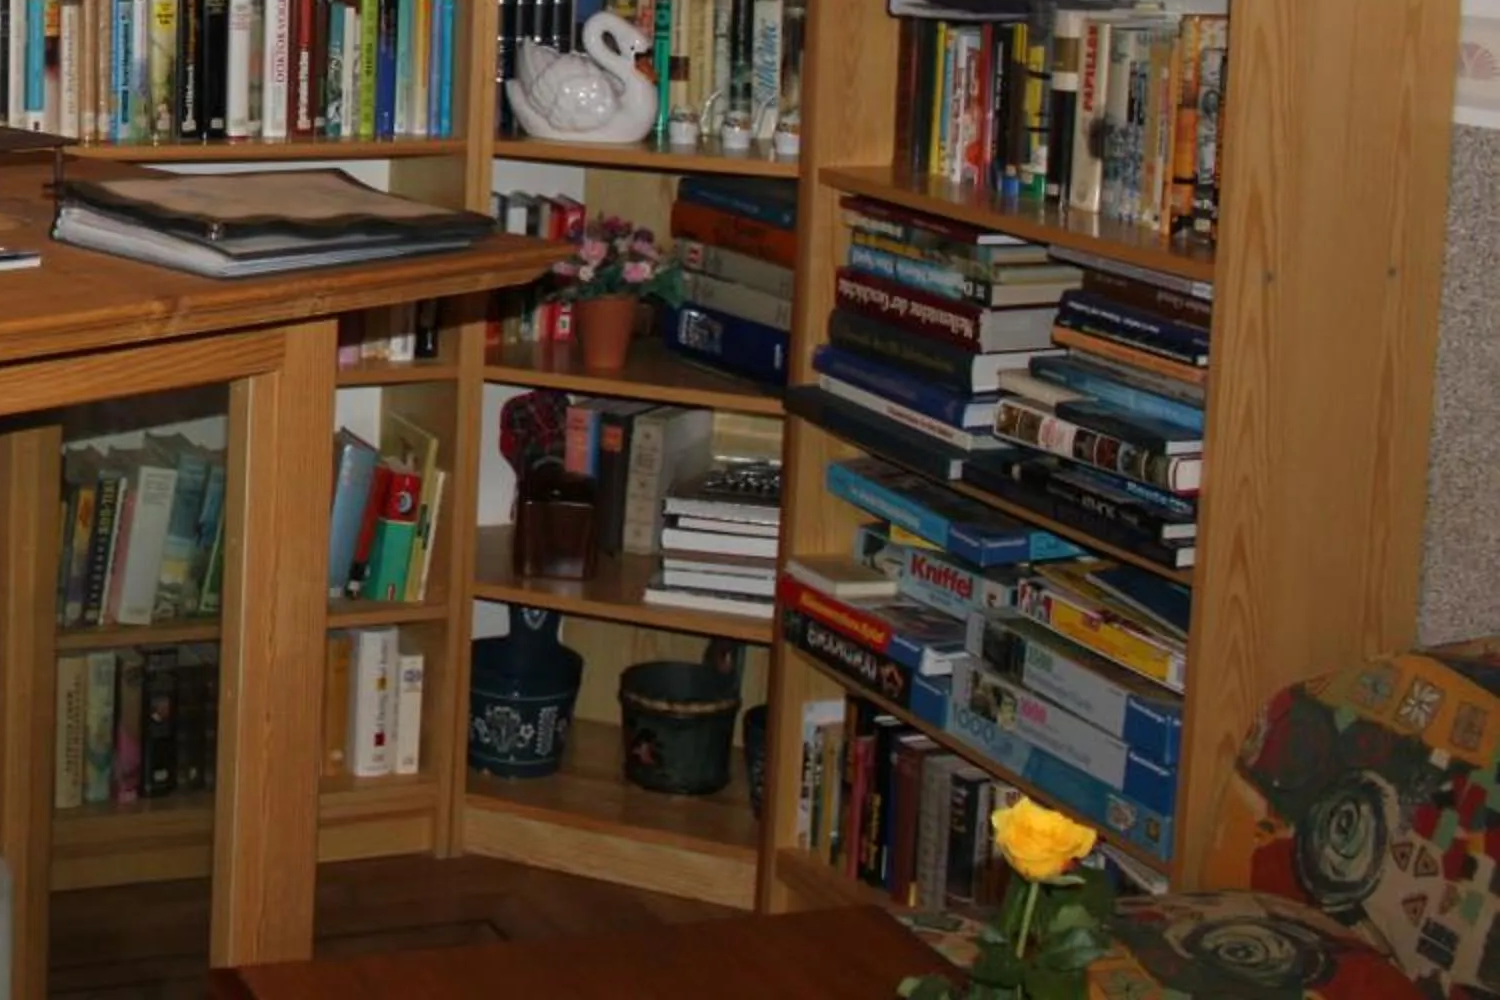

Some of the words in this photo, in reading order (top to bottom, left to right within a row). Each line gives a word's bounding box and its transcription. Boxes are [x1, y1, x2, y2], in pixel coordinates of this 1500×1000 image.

[274, 31, 286, 83] DOKTOR
[1083, 25, 1098, 112] PAPILLON
[910, 553, 974, 600] Kniffel
